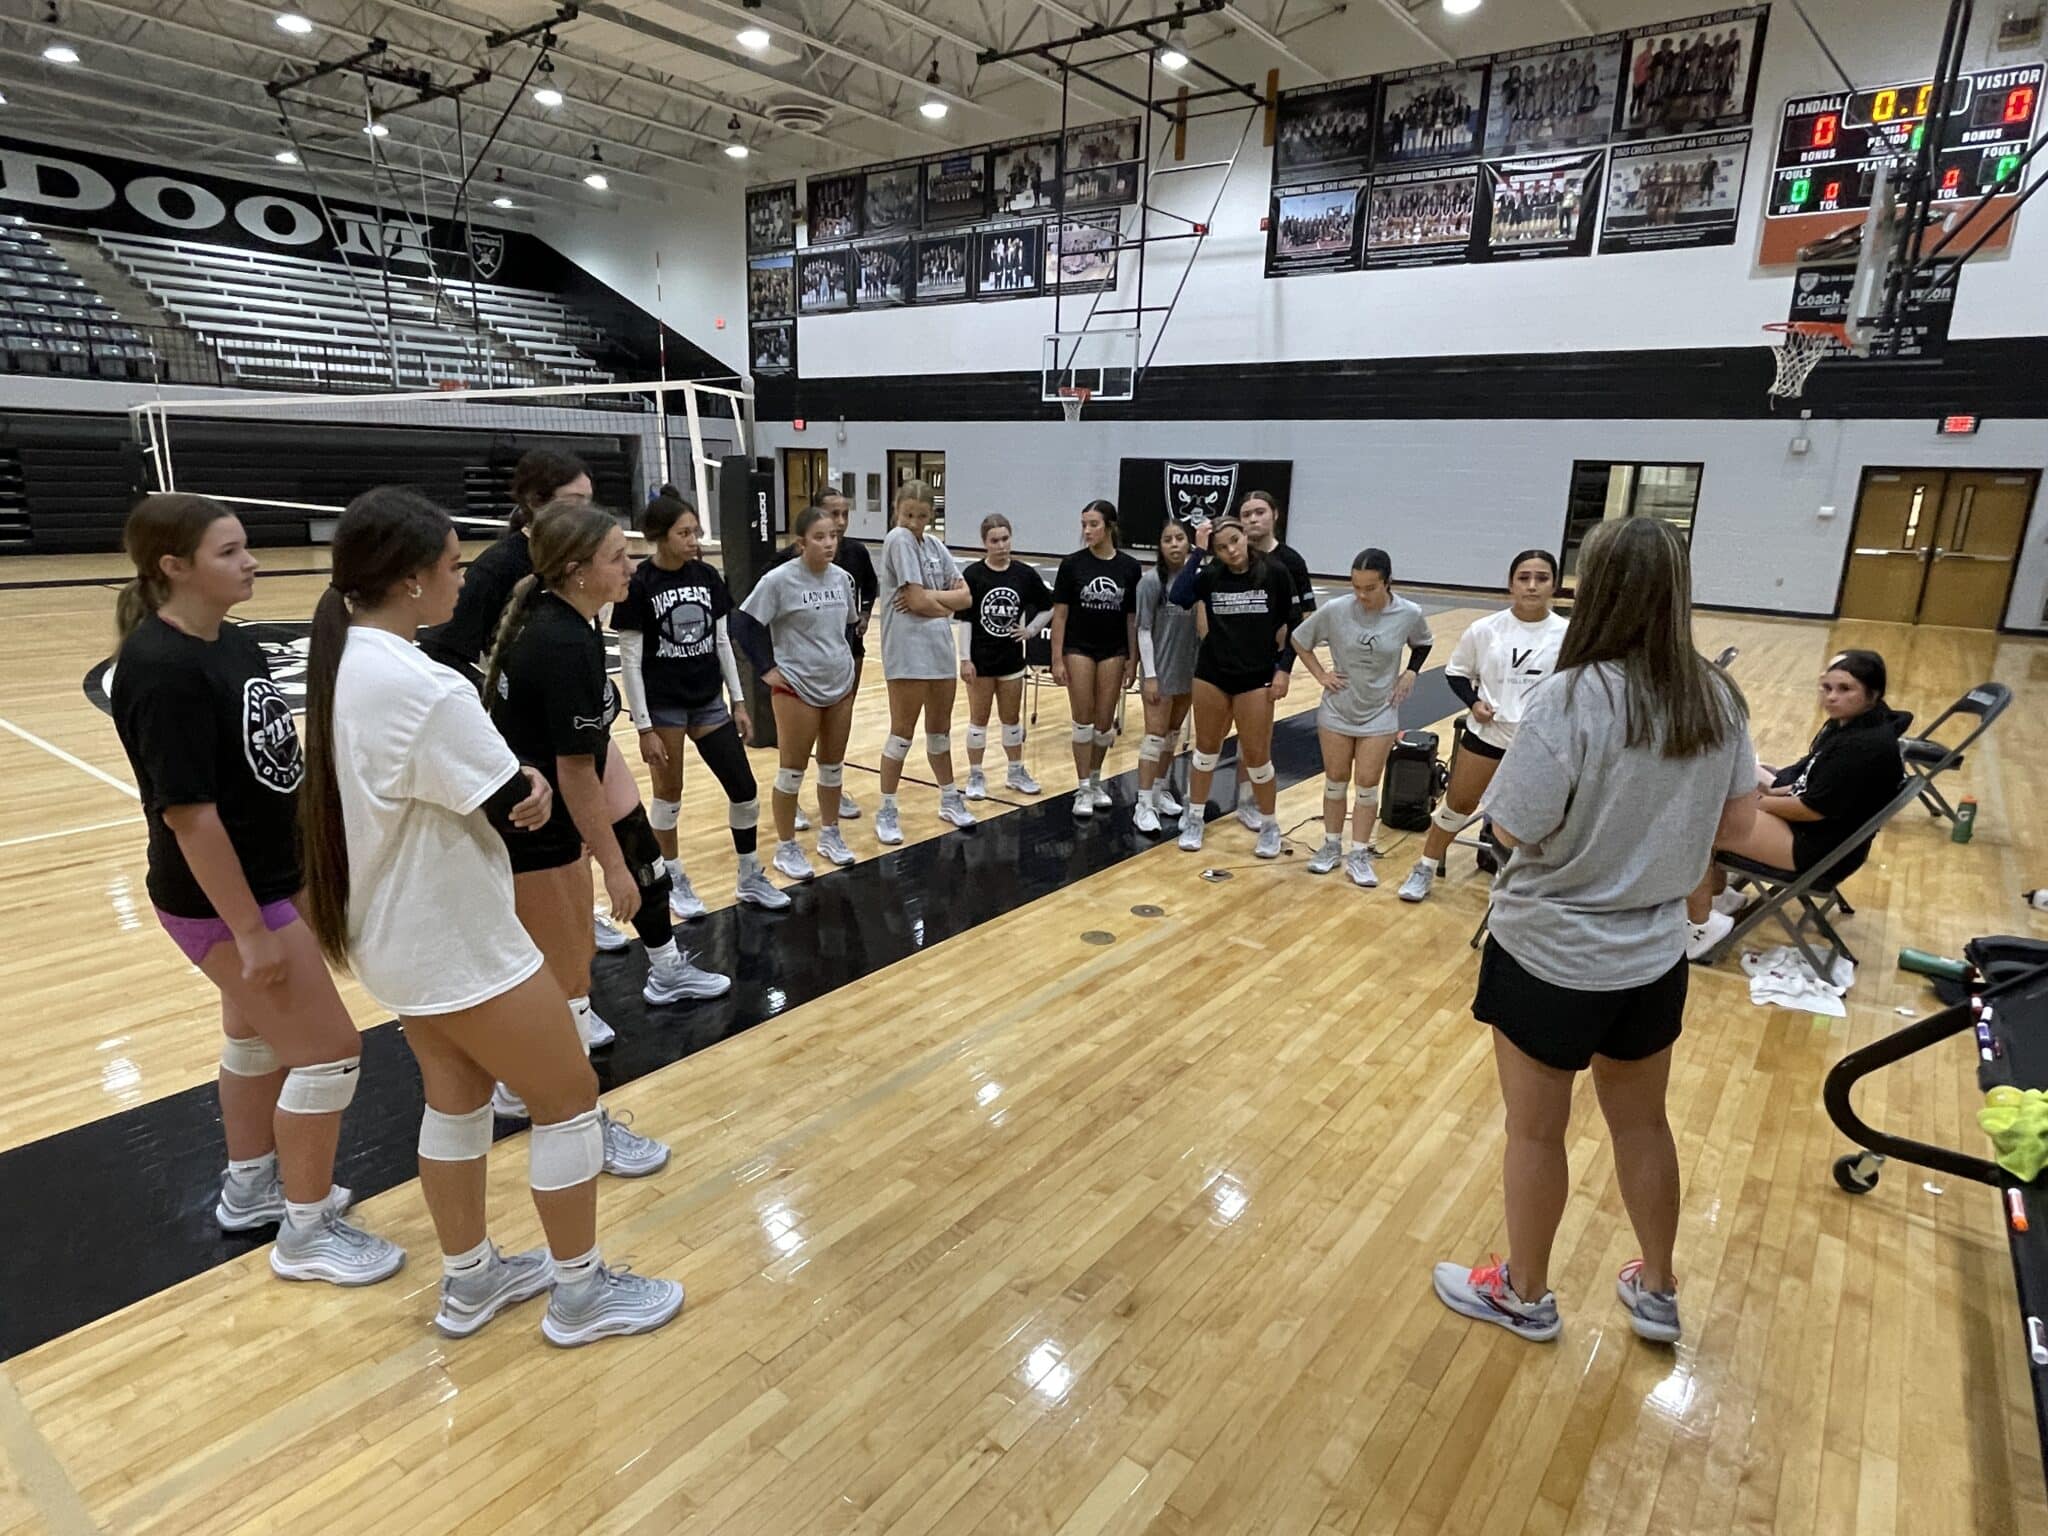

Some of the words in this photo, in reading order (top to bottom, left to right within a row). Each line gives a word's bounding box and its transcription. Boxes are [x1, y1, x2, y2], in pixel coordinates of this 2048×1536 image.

[1976, 69, 2041, 90] VISITOR
[1786, 97, 1843, 117] RANDALL
[2004, 88, 2033, 122] 0
[1813, 115, 1837, 147] 0
[1961, 128, 2003, 143] BONUS
[1867, 133, 1909, 148] PEIOD
[1800, 148, 1836, 161] BONUS
[1983, 143, 2021, 158] FOULS
[1779, 168, 1812, 180] FOULS
[1791, 179, 1810, 203] 0
[0, 149, 438, 266] DOOM
[1797, 291, 1841, 306] Coach
[1171, 473, 1230, 486] RAIDERS
